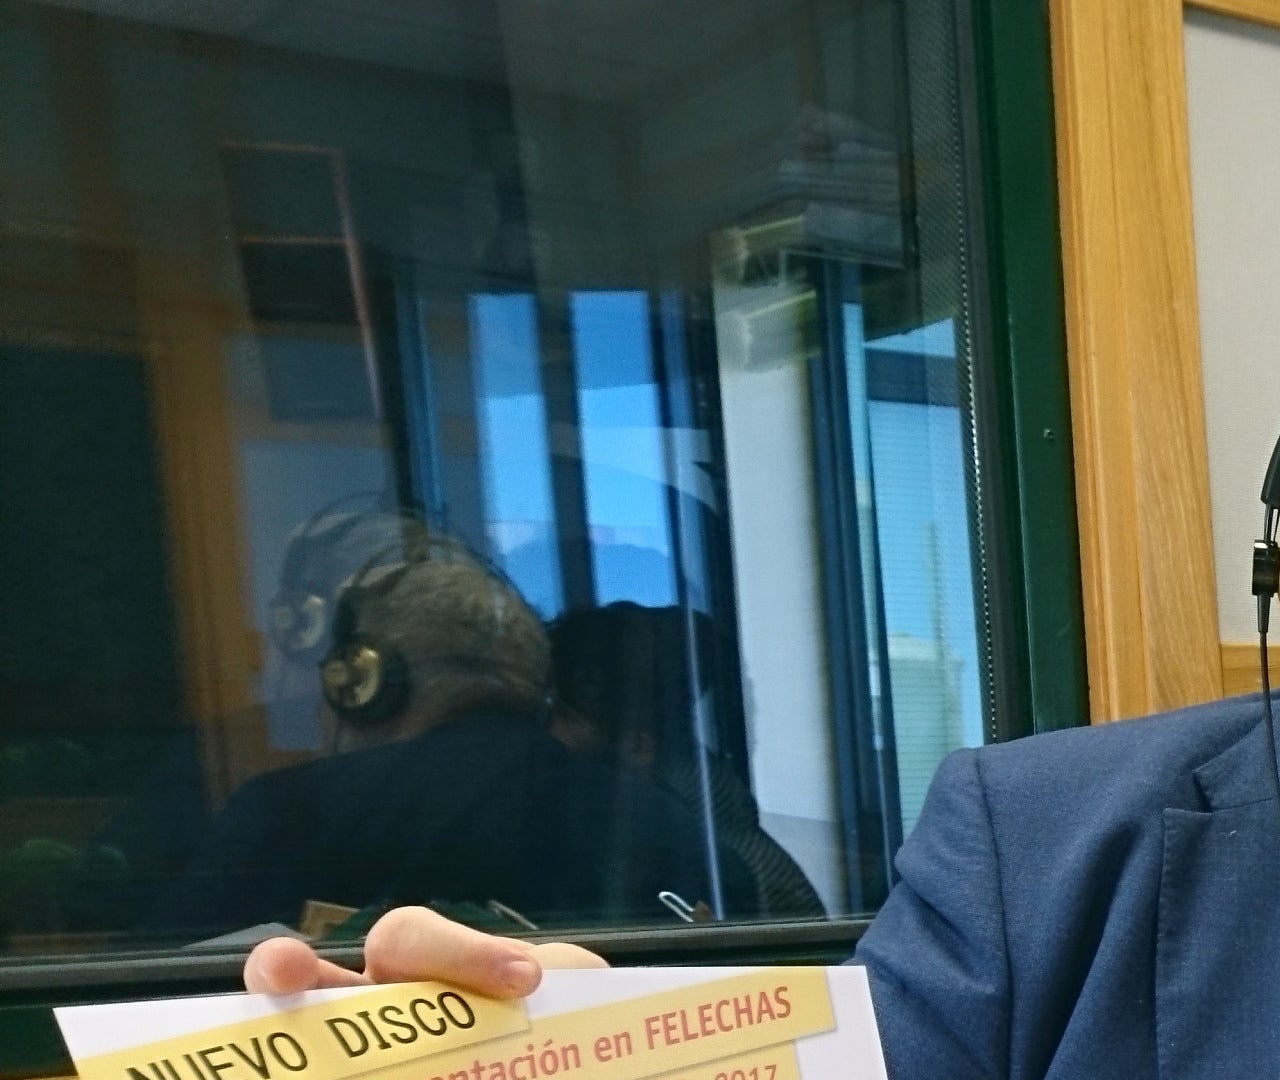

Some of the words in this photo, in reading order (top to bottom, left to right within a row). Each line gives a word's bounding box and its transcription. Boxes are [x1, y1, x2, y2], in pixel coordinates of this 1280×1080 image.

[326, 990, 477, 1060] DISCO
[593, 1030, 634, 1063] en
[645, 986, 793, 1050] FELECHAS
